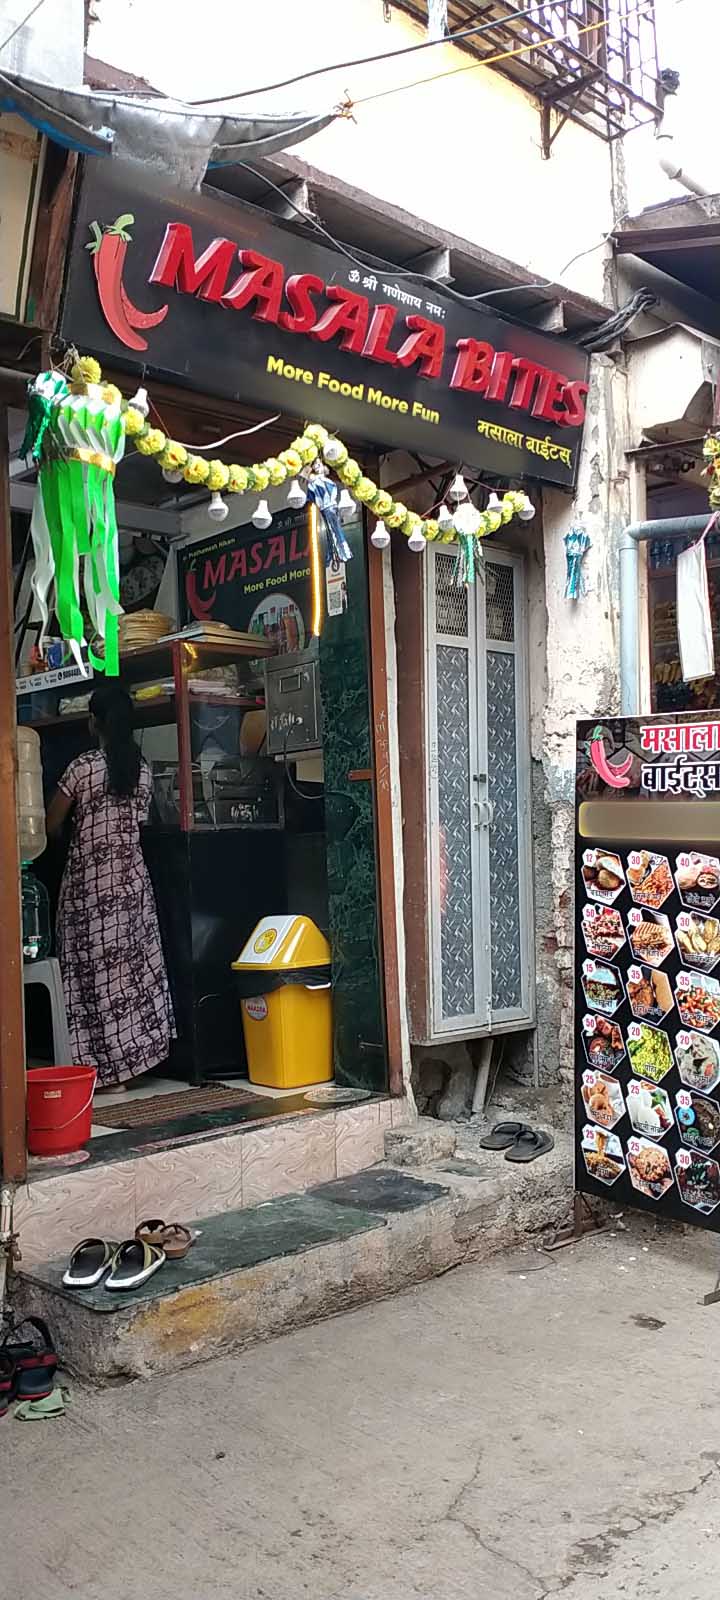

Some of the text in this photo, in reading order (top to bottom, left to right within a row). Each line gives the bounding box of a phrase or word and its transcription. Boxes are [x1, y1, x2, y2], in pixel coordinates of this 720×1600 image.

[362, 275, 378, 292] श्री
[382, 283, 423, 310] गणेशाय
[425, 301, 446, 319] नमः
[148, 222, 588, 427] MASALA BITES
[267, 355, 440, 425] More Food More Fun
[477, 418, 573, 470] मसाला बाईटस्
[243, 567, 311, 595] More Food More
[640, 721, 720, 753] मसाला
[631, 855, 640, 864] 30
[680, 858, 689, 867] 40
[585, 908, 594, 918] 50
[680, 918, 689, 927] 30
[585, 963, 593, 972] 15
[631, 970, 640, 979] 35
[680, 976, 689, 986] 35
[631, 1027, 640, 1037] 20
[585, 1075, 594, 1084] 25
[631, 1085, 640, 1094] 25
[680, 1096, 689, 1105] 35
[585, 1130, 594, 1138] 25
[631, 1142, 640, 1151] 25
[680, 1155, 689, 1164] 30
